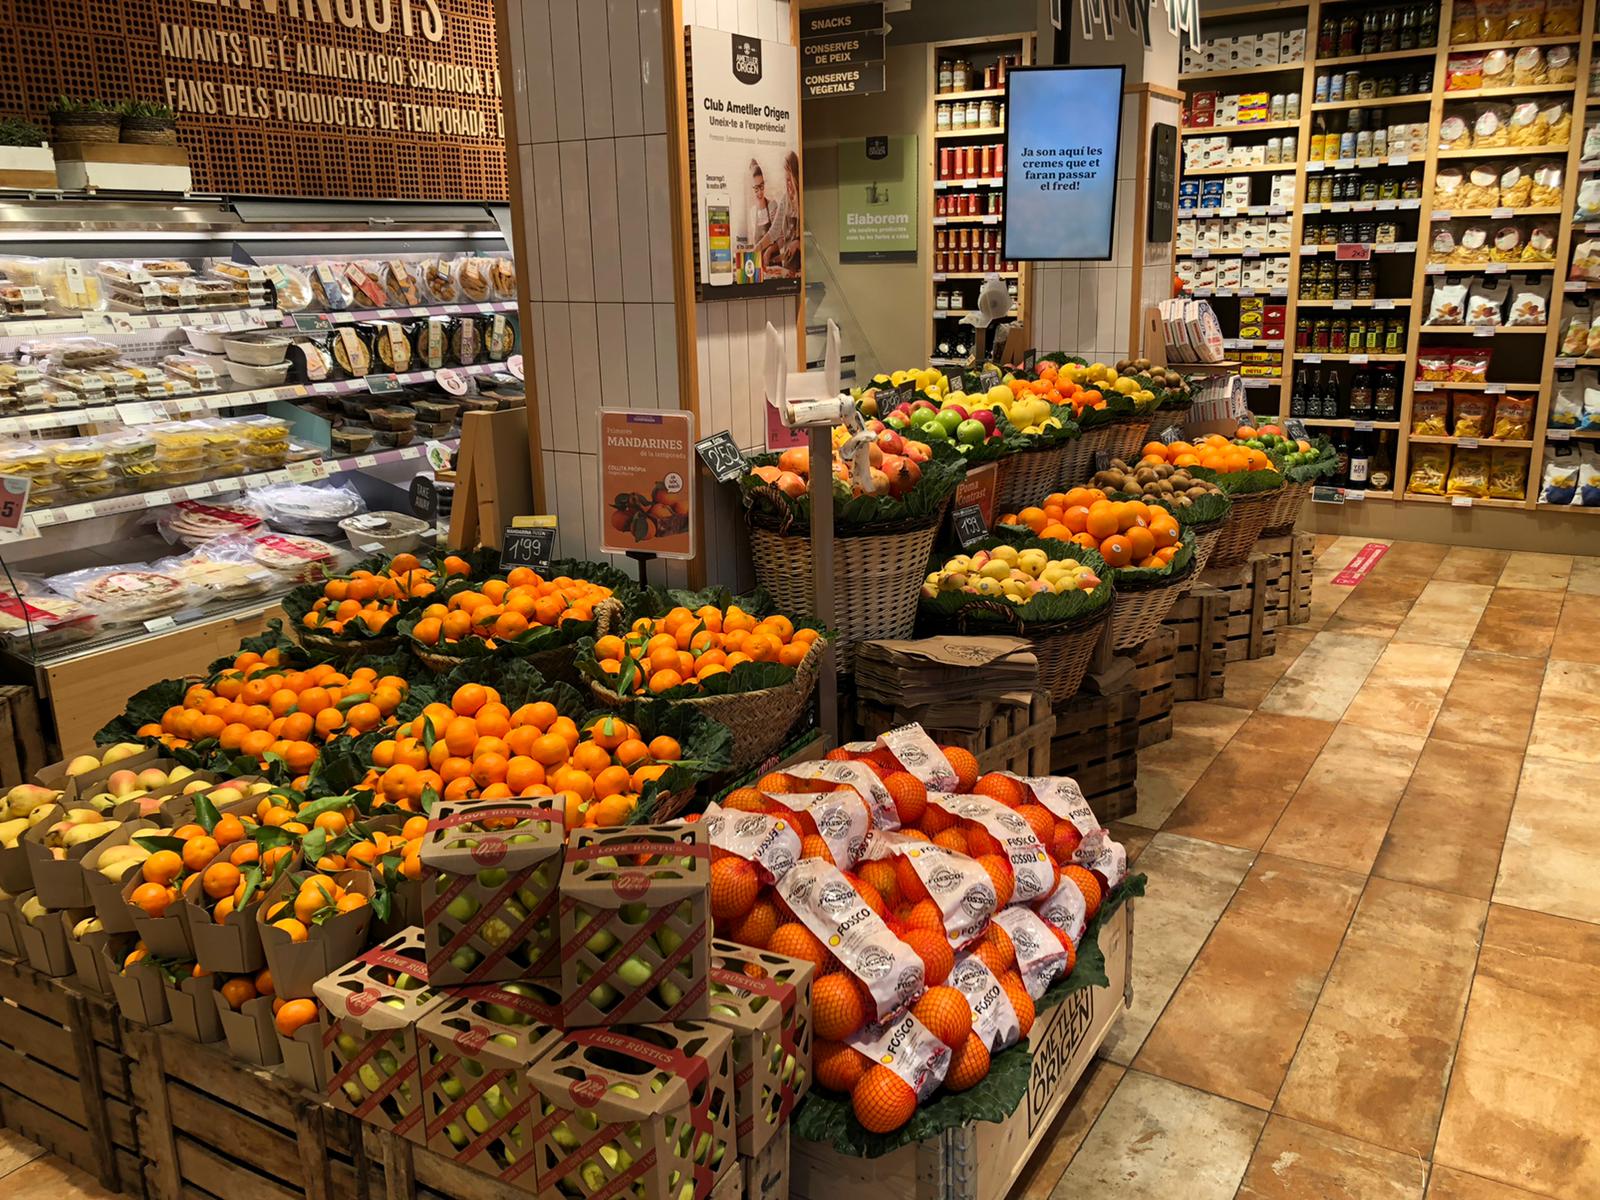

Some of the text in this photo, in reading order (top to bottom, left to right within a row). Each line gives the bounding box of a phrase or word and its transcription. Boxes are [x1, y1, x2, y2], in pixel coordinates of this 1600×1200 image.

[811, 16, 852, 30] SNACKS
[805, 40, 859, 55] CONSERVES
[160, 23, 243, 66] AMANTS
[250, 36, 275, 69] DE
[409, 59, 483, 96] SABOROSA
[815, 52, 851, 64] DE PEIX
[736, 62, 759, 75] ORIGEN
[805, 71, 860, 85] CONSERVES
[810, 82, 855, 95] VEGETALS
[165, 78, 217, 115] FANS
[223, 84, 269, 119] DELS
[275, 89, 375, 129] PRODUCTES
[378, 101, 400, 130] DE
[703, 97, 790, 121] Club Ametller Origen
[709, 116, 738, 129] Uneix-te
[739, 121, 744, 129] a
[1021, 146, 1103, 158] Ja son aquí les
[1022, 159, 1100, 169] cremes que et
[1025, 170, 1097, 181] faran passar
[1040, 181, 1080, 191] el fred!
[847, 213, 909, 225] Elaborem
[607, 436, 683, 450] MANDARINES
[598, 845, 629, 854] LOVE
[837, 908, 871, 937] FOSSCO
[596, 1034, 624, 1046] LOVE
[887, 1018, 914, 1055] FOSSCO
[1033, 992, 1089, 1116] ORIGEN
